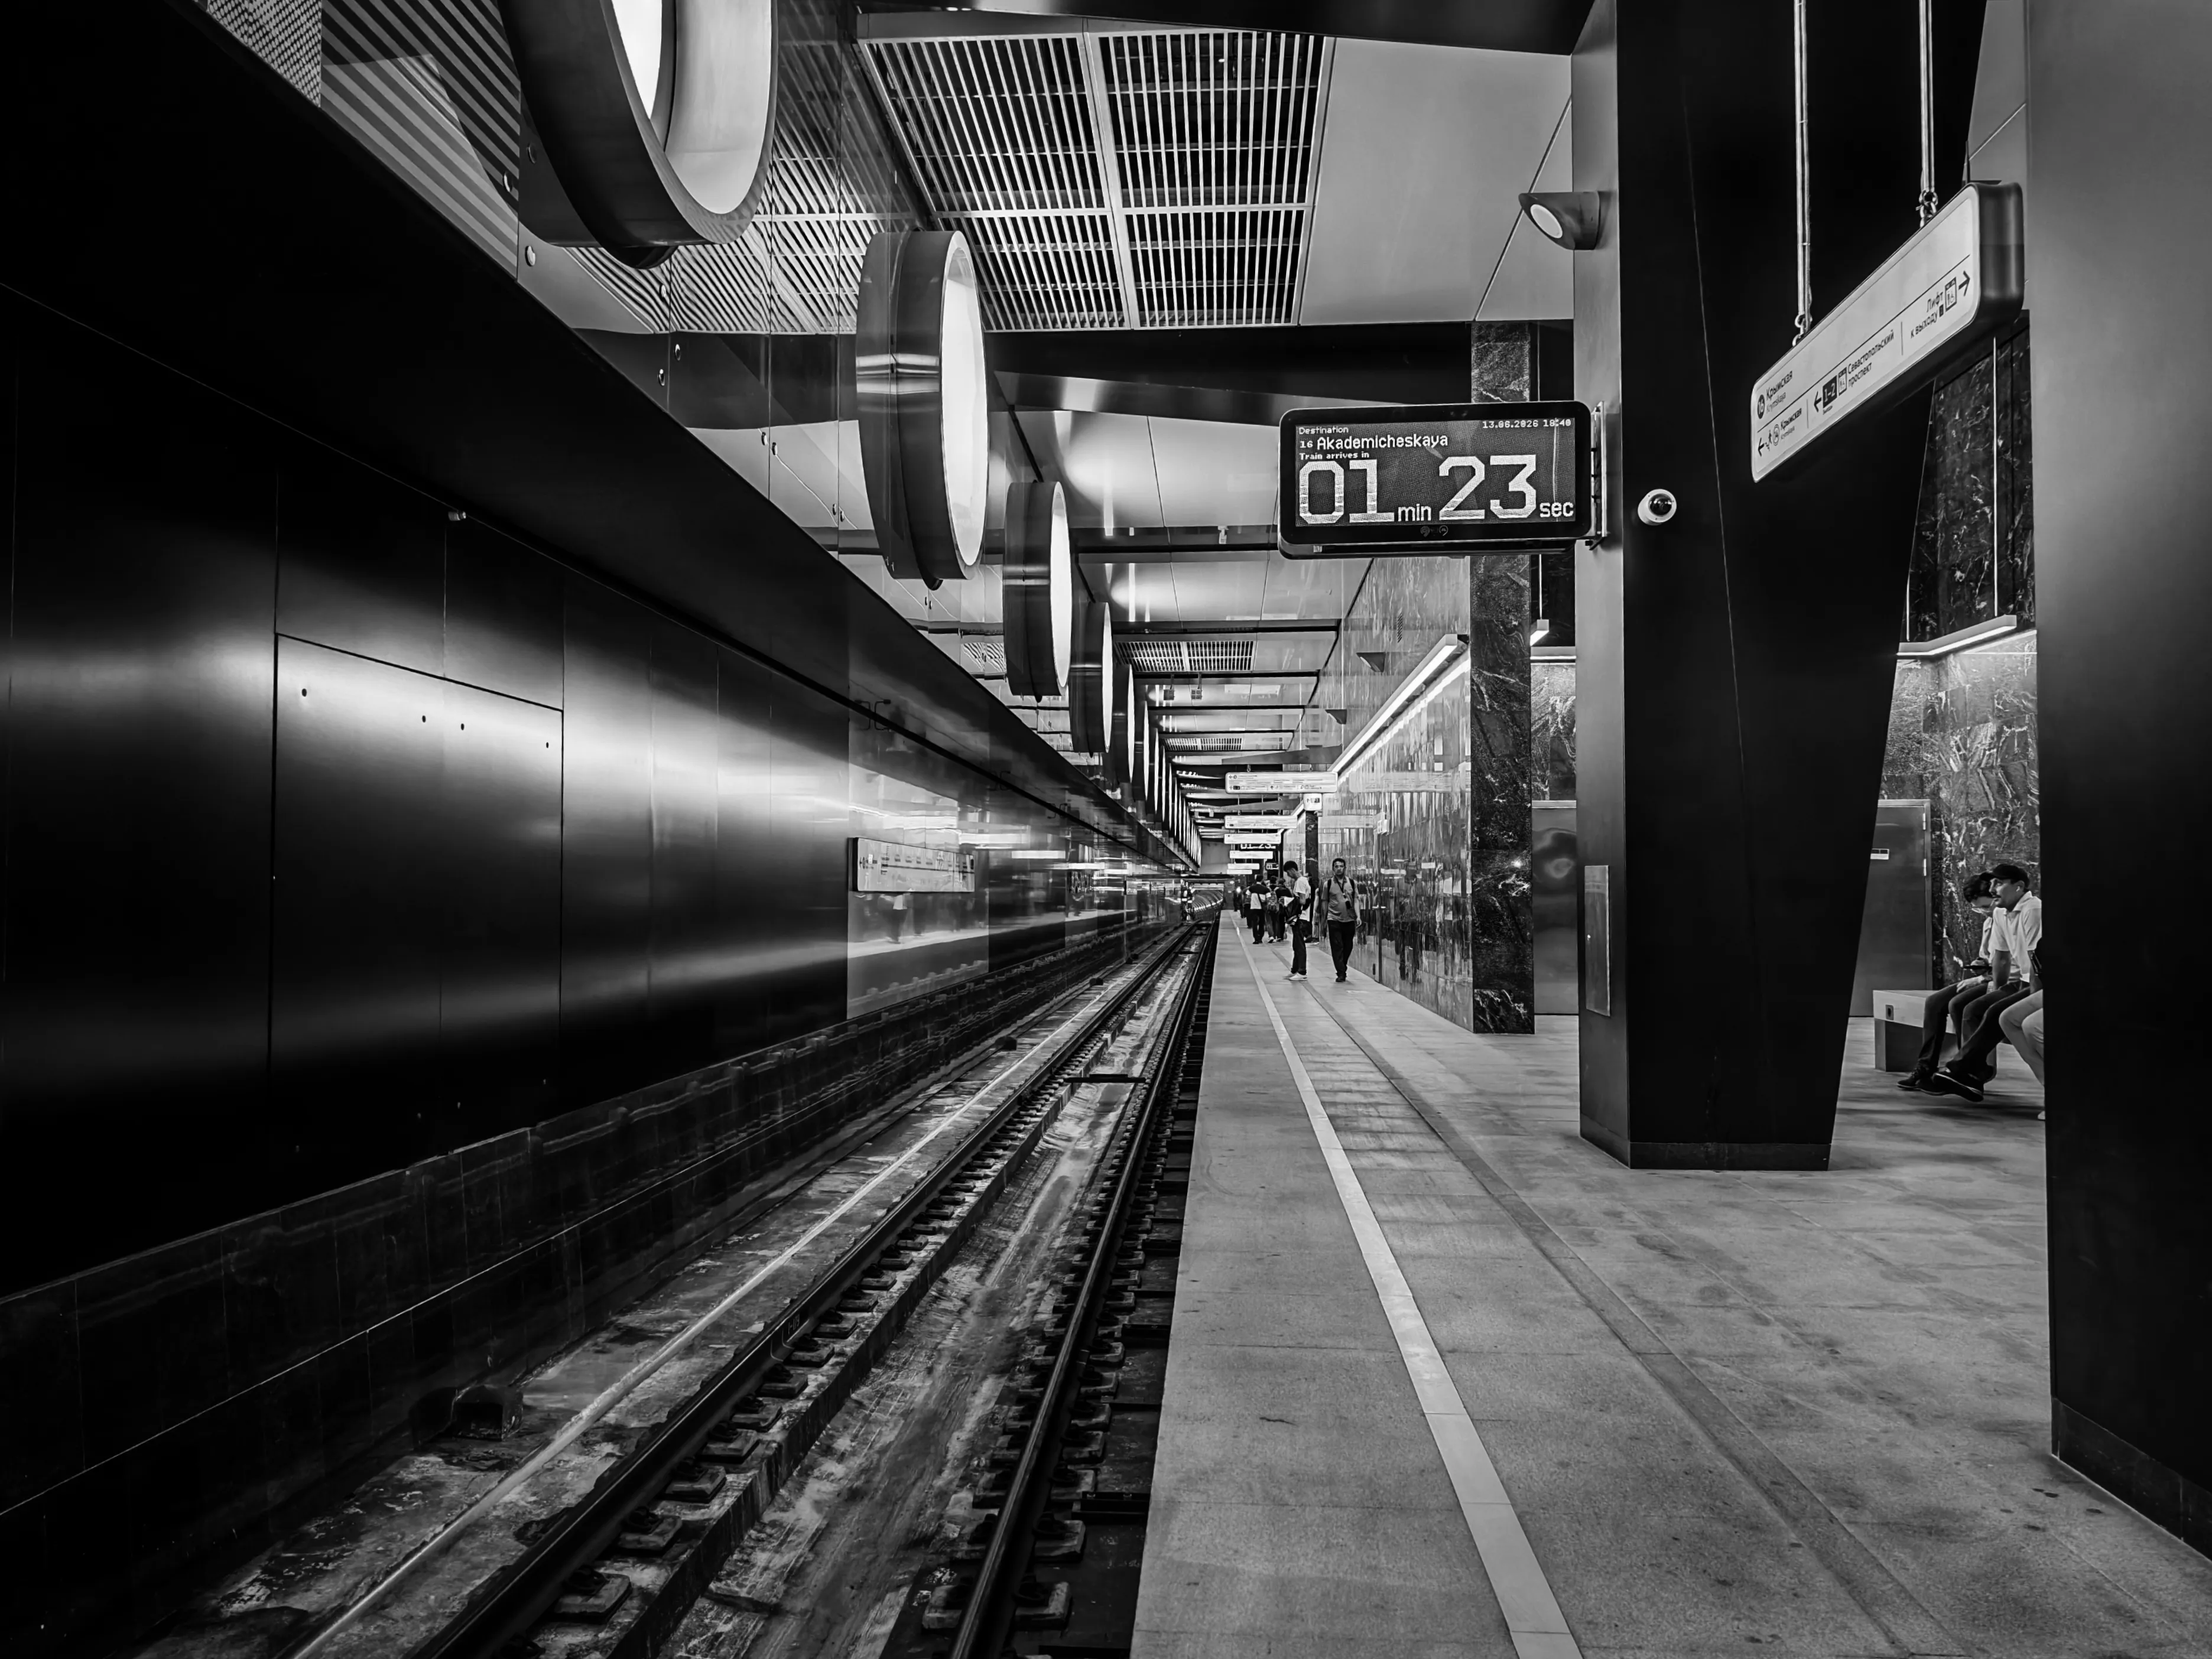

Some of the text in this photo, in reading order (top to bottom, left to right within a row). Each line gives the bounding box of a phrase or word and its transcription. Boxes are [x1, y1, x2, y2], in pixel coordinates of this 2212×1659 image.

[1927, 292, 1943, 313] Лифт
[1848, 329, 1894, 374] Севастопольский
[1766, 370, 1792, 401] Крымская
[1849, 362, 1872, 388] проспект
[1824, 383, 1836, 402] 1-2
[1299, 426, 1349, 434] Destination
[1482, 419, 1571, 428] 13.06.2026 18:40
[1317, 434, 1448, 450] Akademicheskaya
[1300, 454, 1574, 524] 01 min 23 sec
